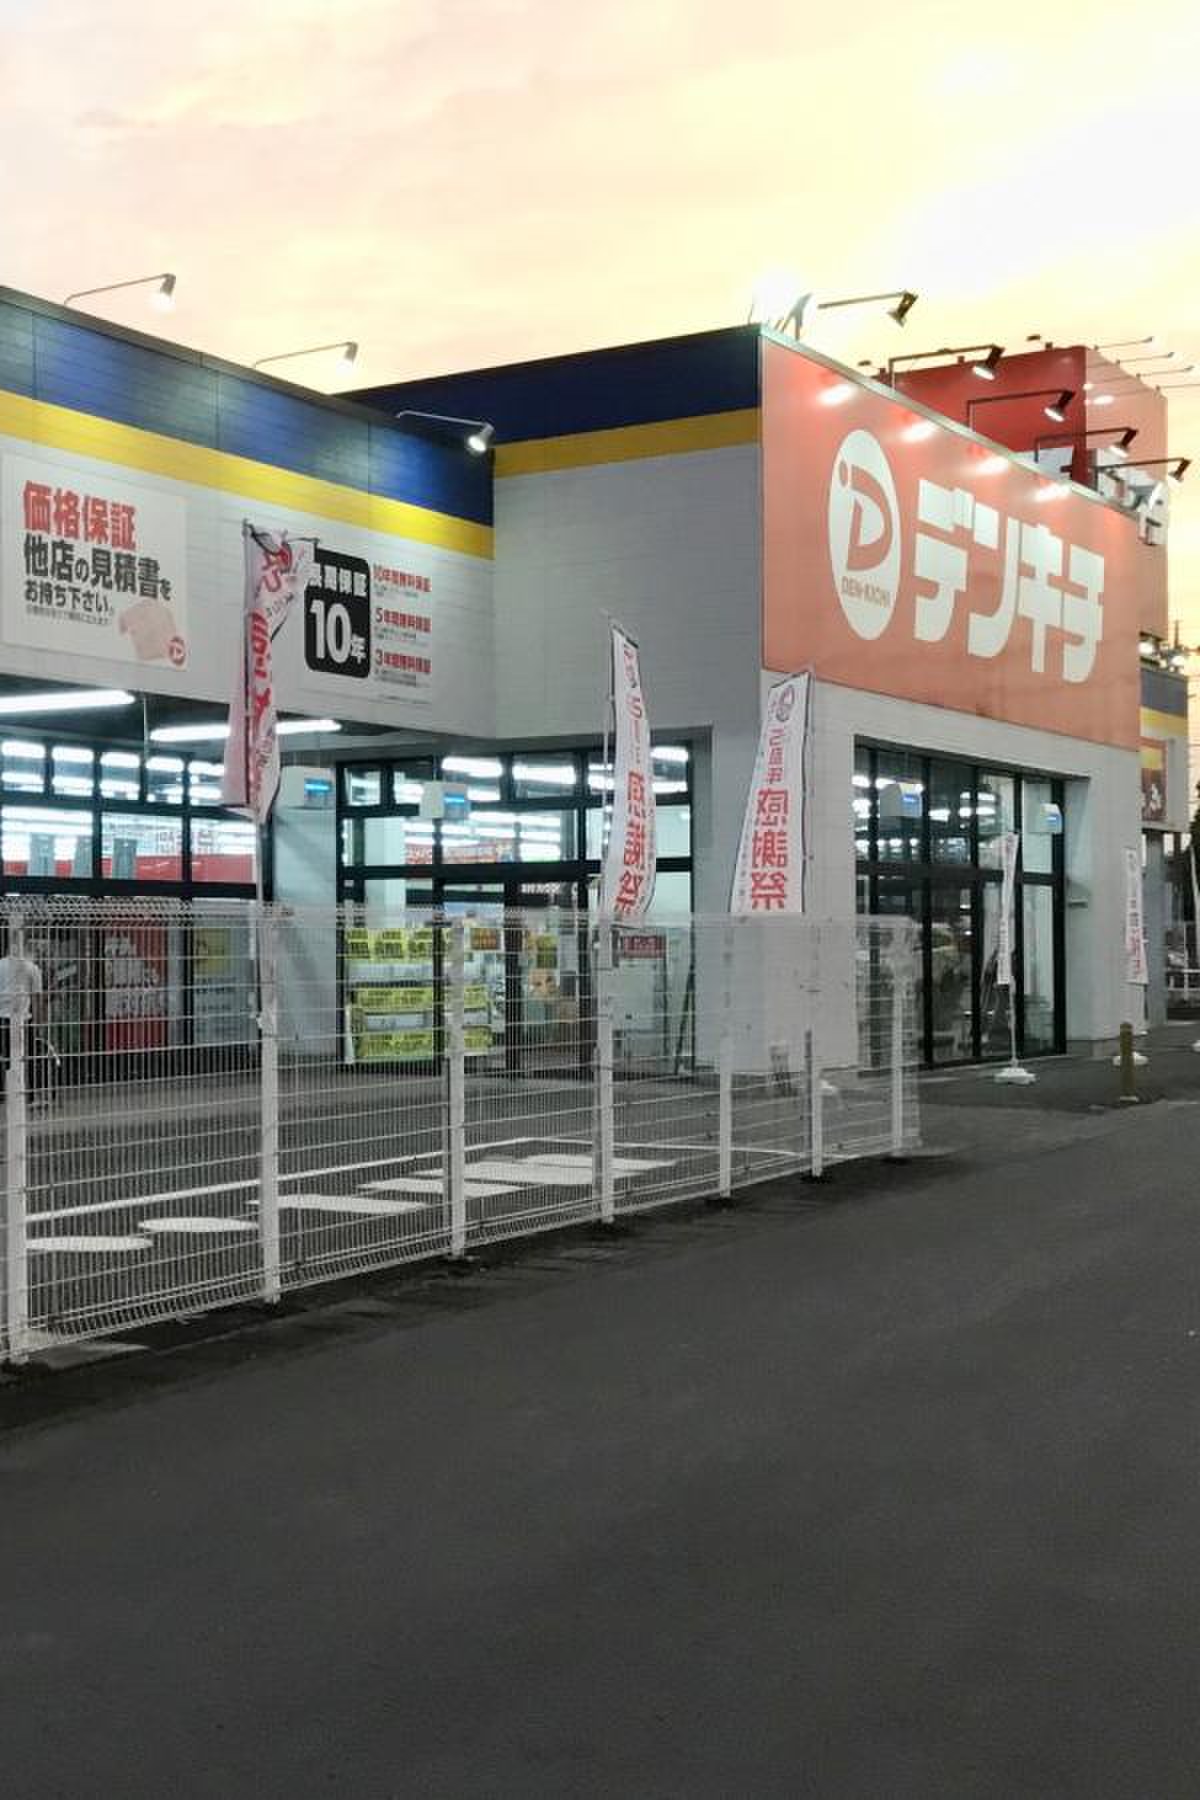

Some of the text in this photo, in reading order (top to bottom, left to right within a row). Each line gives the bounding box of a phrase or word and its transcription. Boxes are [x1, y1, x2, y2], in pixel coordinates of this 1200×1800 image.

[23, 480, 136, 552] 価格保証
[23, 532, 172, 601] 他店の見積書を
[913, 478, 1105, 683] デンキチ
[310, 599, 367, 664] 10年
